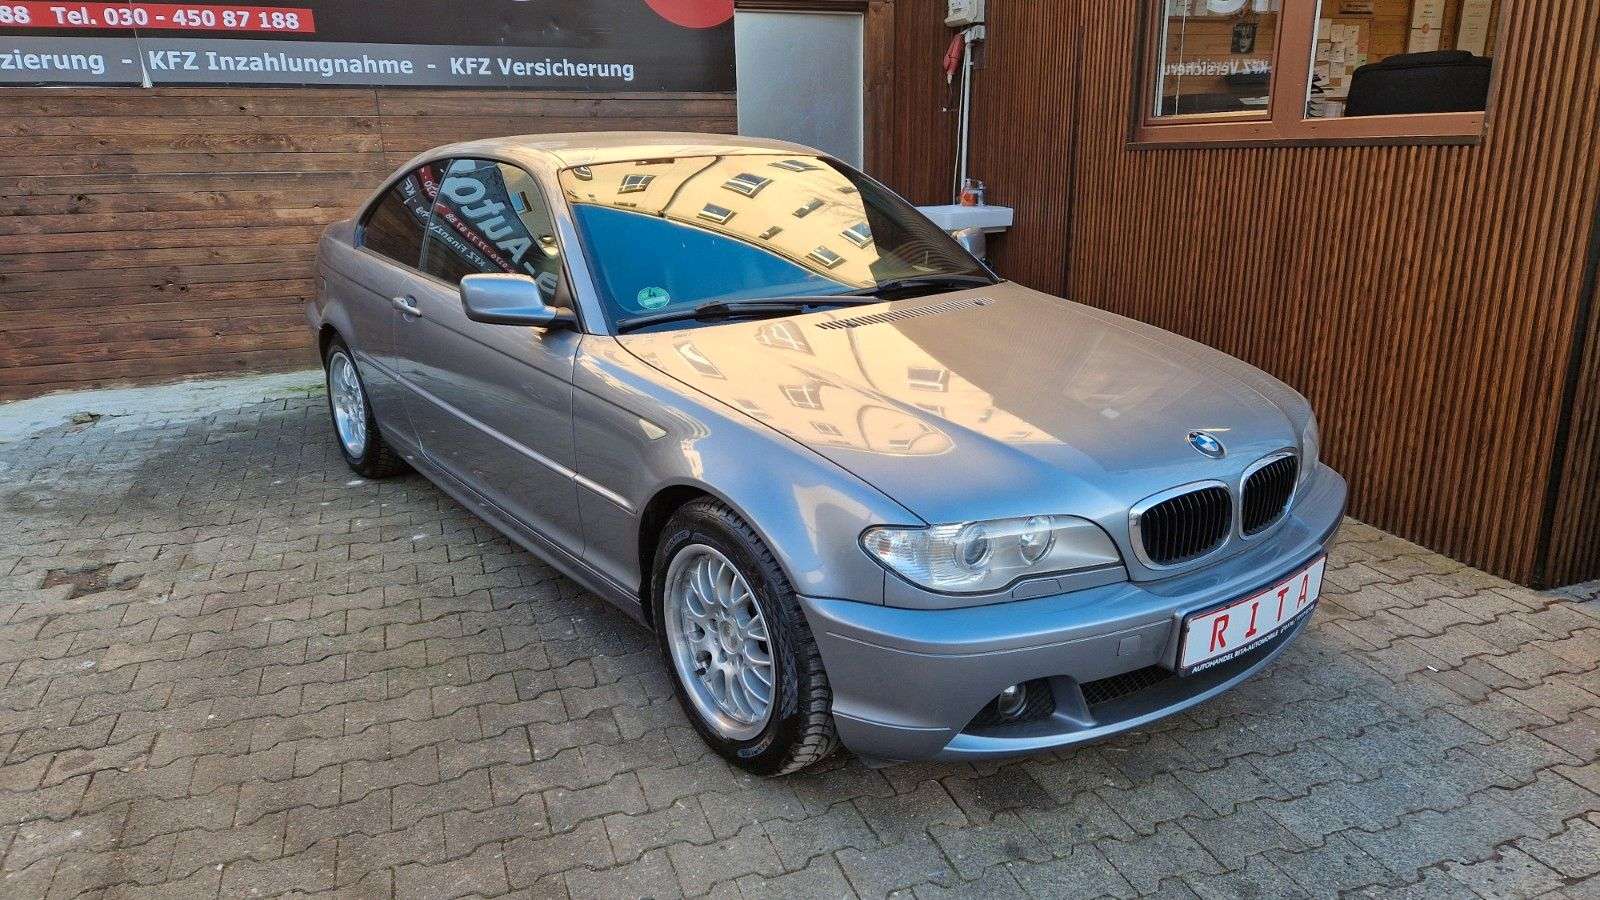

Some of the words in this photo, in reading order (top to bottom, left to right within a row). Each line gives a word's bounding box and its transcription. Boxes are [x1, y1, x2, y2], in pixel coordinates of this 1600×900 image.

[0, 7, 30, 25] 88
[50, 7, 96, 25] Tel.
[104, 8, 149, 26] 030
[172, 9, 216, 27] 450
[223, 11, 250, 28] 87
[258, 11, 301, 30] 188
[0, 48, 105, 75] zierung
[149, 50, 200, 71] KFZ
[205, 51, 414, 78] Inzahlungnahme
[450, 57, 492, 76] KFZ
[497, 57, 635, 81] Versicherung
